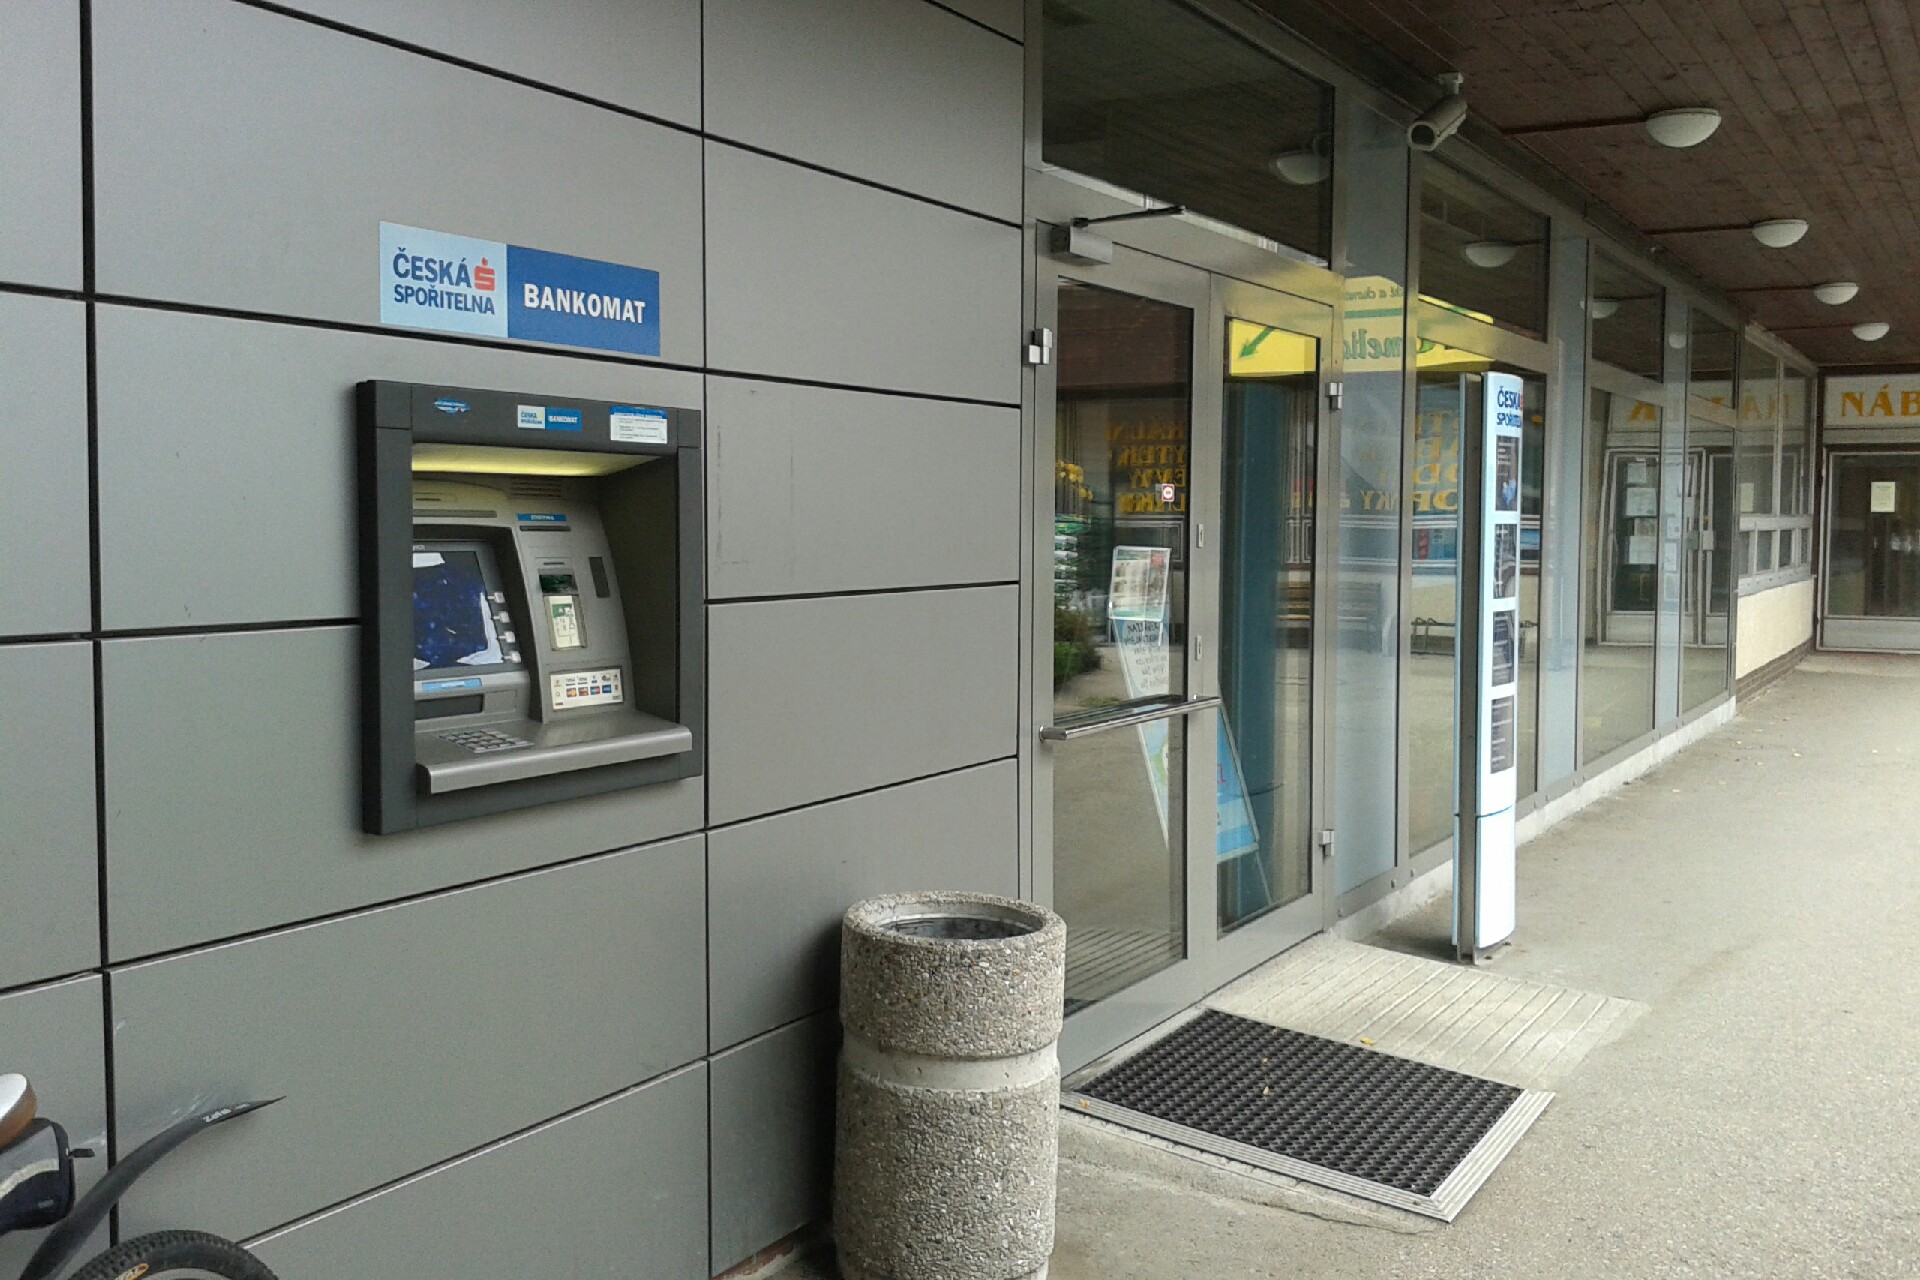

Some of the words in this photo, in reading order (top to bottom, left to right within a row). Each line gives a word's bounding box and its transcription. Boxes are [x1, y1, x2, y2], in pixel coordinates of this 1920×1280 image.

[393, 246, 472, 289] ČESKÁ
[394, 283, 495, 315] SPOŘITELNA
[523, 283, 646, 324] BANKOMAT
[1841, 384, 1920, 417] NÁB
